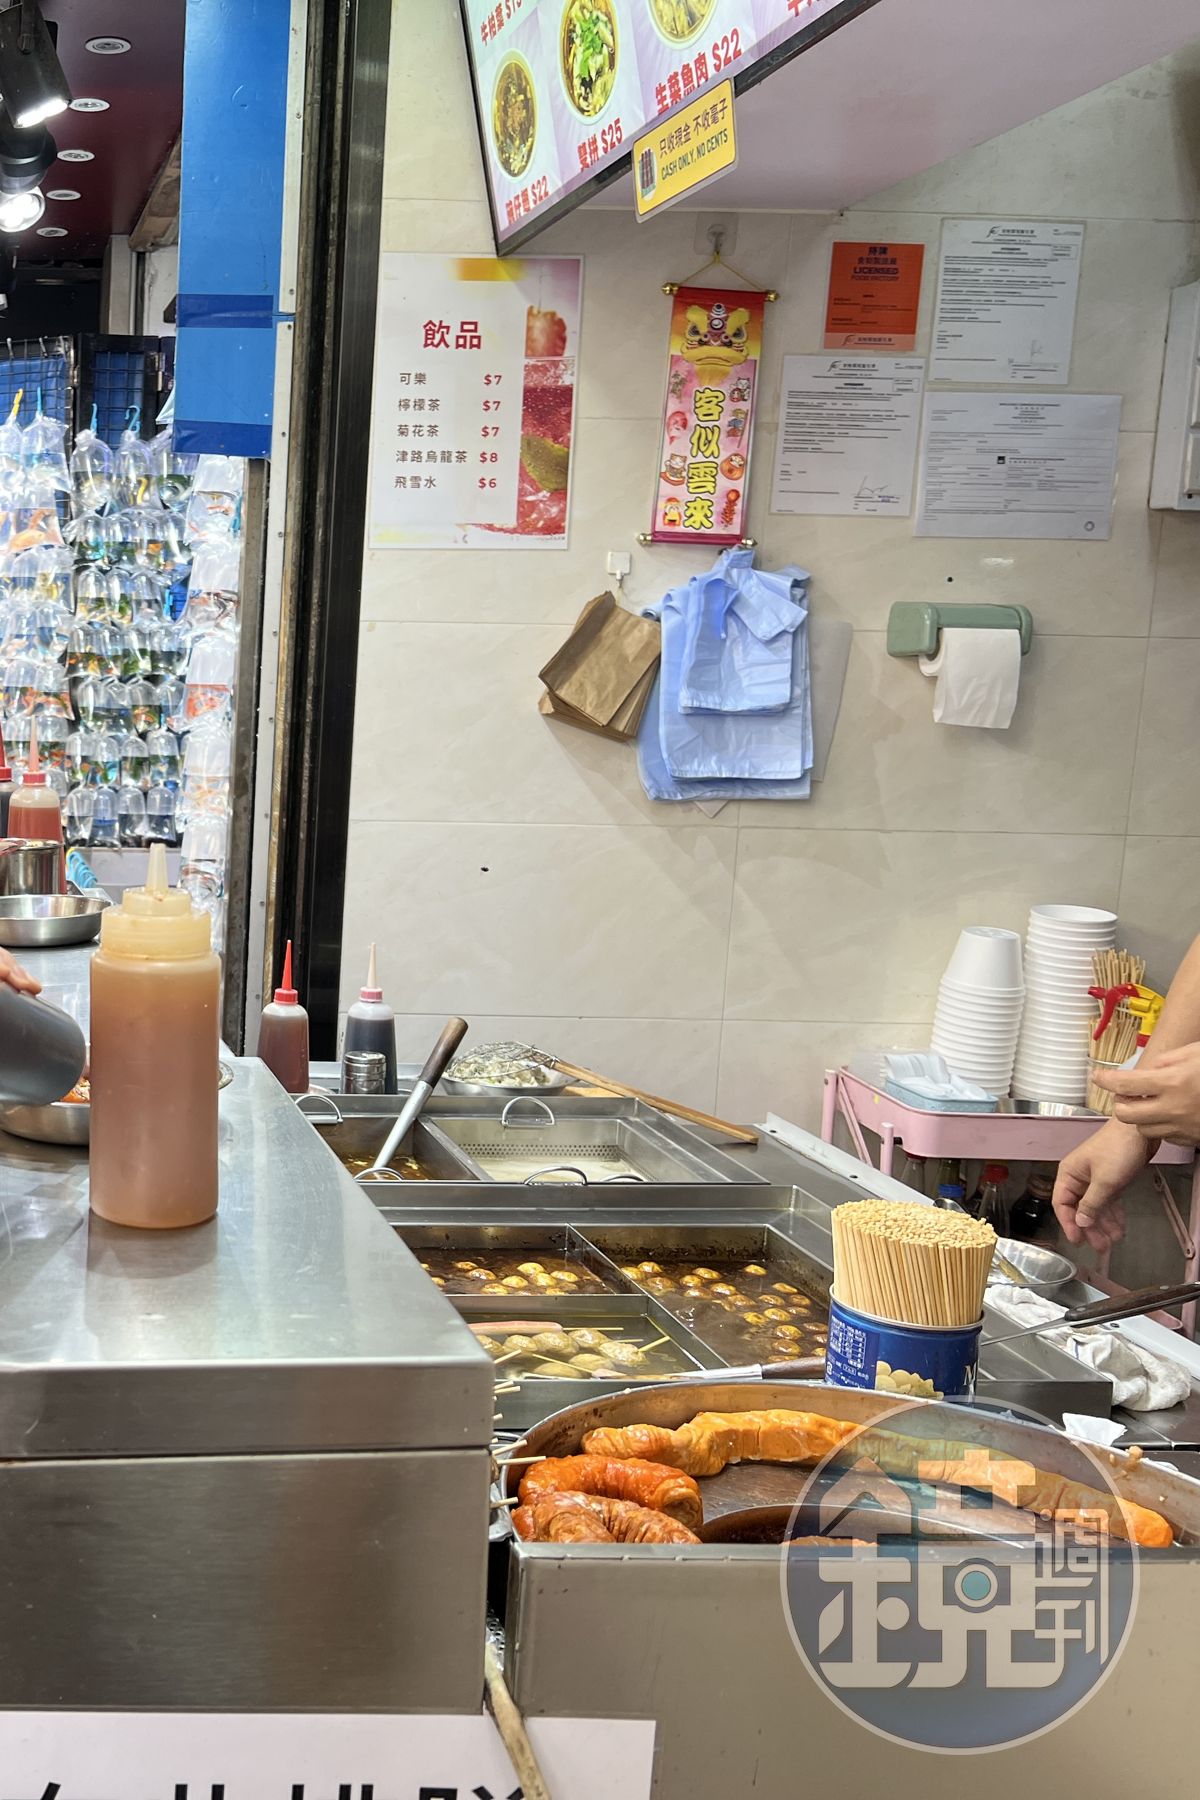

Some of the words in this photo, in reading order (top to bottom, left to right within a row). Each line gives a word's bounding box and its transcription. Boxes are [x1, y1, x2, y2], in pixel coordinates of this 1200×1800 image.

[656, 52, 709, 115] 生菜魚肉
[660, 123, 691, 158] 只收現金
[693, 98, 728, 136] 不收毫子
[662, 161, 678, 180] CASH
[696, 146, 705, 160] NO
[706, 128, 728, 153] CENTS
[853, 267, 899, 275] LICENSED
[422, 320, 482, 350] 飲品
[399, 373, 427, 385] 可樂
[484, 374, 502, 386] $7
[398, 399, 440, 411] 檸檬茶
[482, 400, 501, 412] $7
[397, 425, 439, 437] 菊花茶
[481, 426, 499, 438] $7
[395, 450, 468, 463] 津路烏龍茶
[479, 452, 498, 464] $8
[683, 387, 726, 530] 客似雲來
[394, 476, 437, 489] 飛雪水
[478, 478, 497, 489] $6
